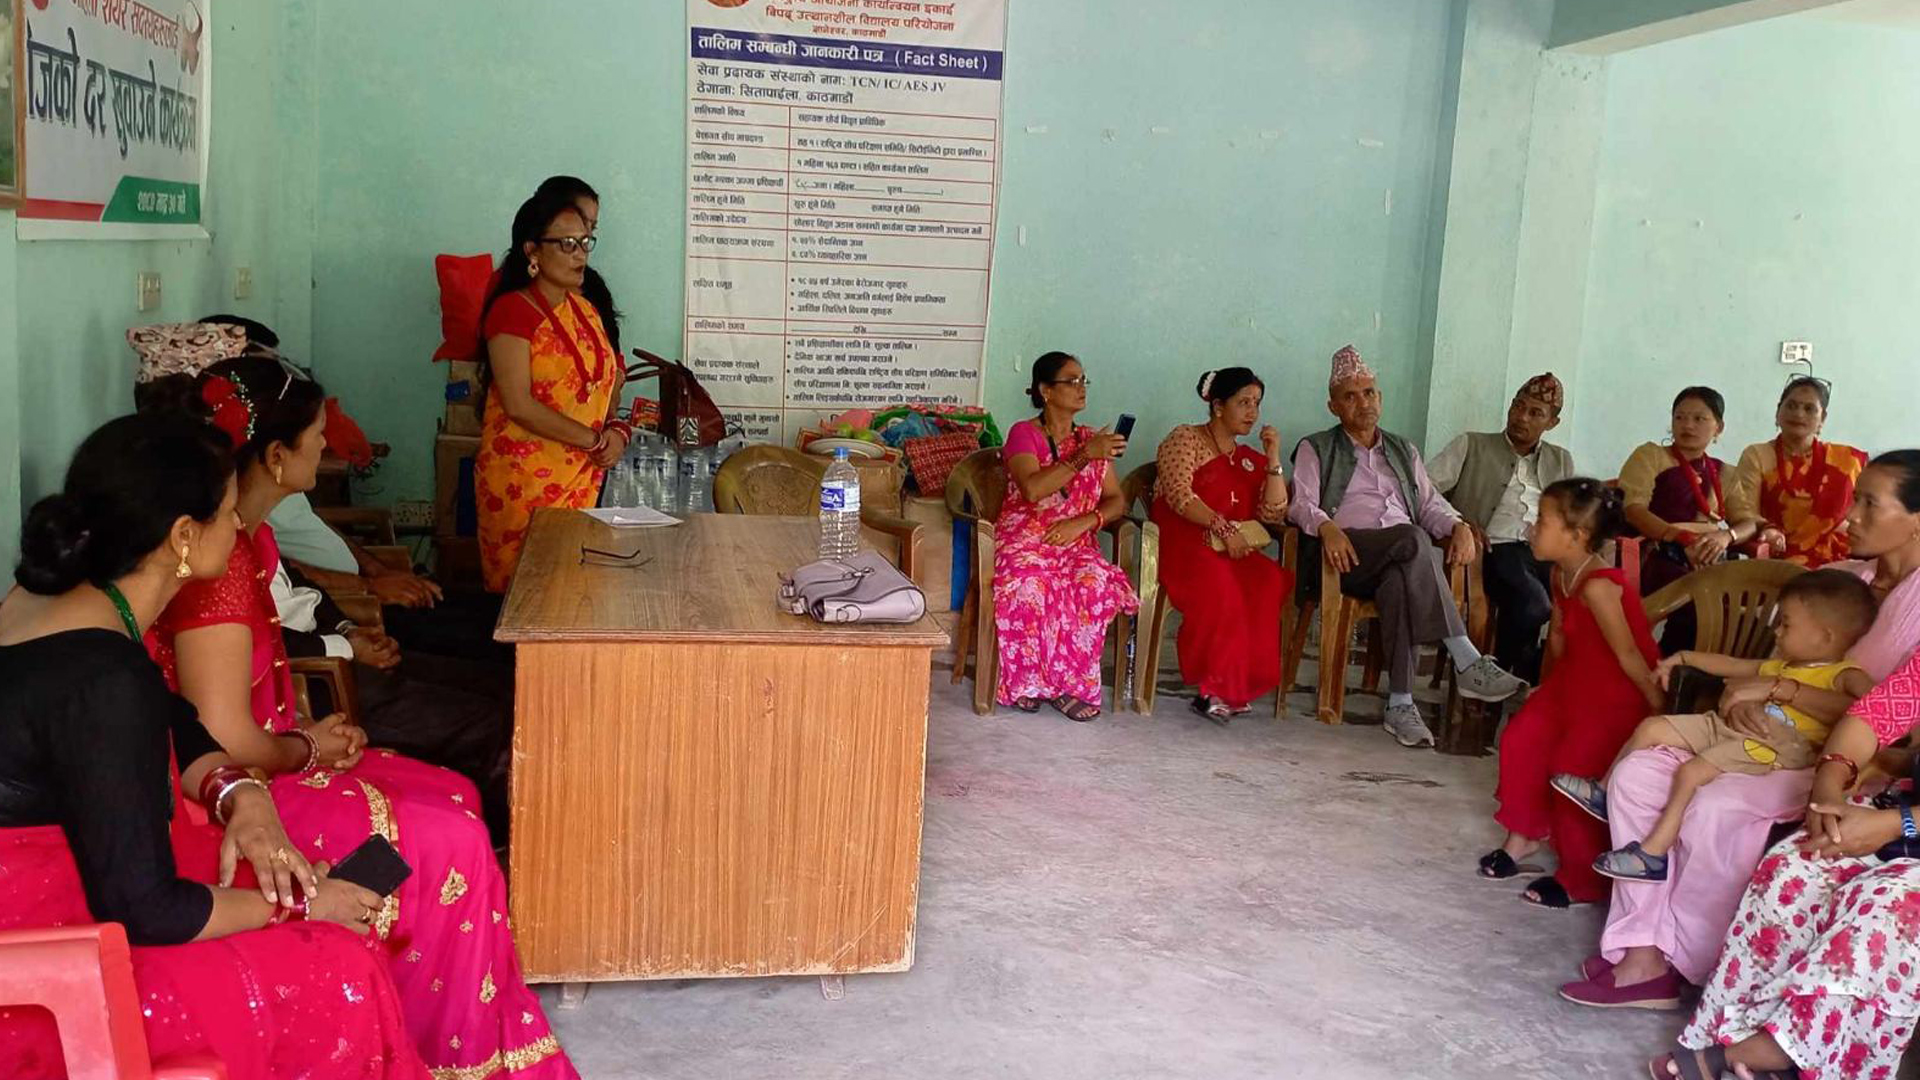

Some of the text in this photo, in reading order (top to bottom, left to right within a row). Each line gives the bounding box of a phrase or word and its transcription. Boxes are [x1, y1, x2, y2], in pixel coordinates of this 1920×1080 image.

[796, 9, 855, 24] उत्थानशील
[860, 11, 899, 27] विद्यालय
[904, 17, 955, 31] परियोजना
[698, 33, 742, 51] तालिम
[746, 39, 796, 56] सम्बन्धी
[801, 44, 859, 61] जानकारी
[863, 49, 884, 63] पत्र
[904, 51, 935, 66] Fact
[938, 52, 979, 69] Sheet
[696, 80, 735, 95] ठेगाना:
[697, 62, 719, 76] सेवा
[723, 66, 764, 80] प्रदायक
[770, 68, 815, 84] संस्थाको
[904, 80, 928, 92] AES
[930, 82, 946, 93] JV
